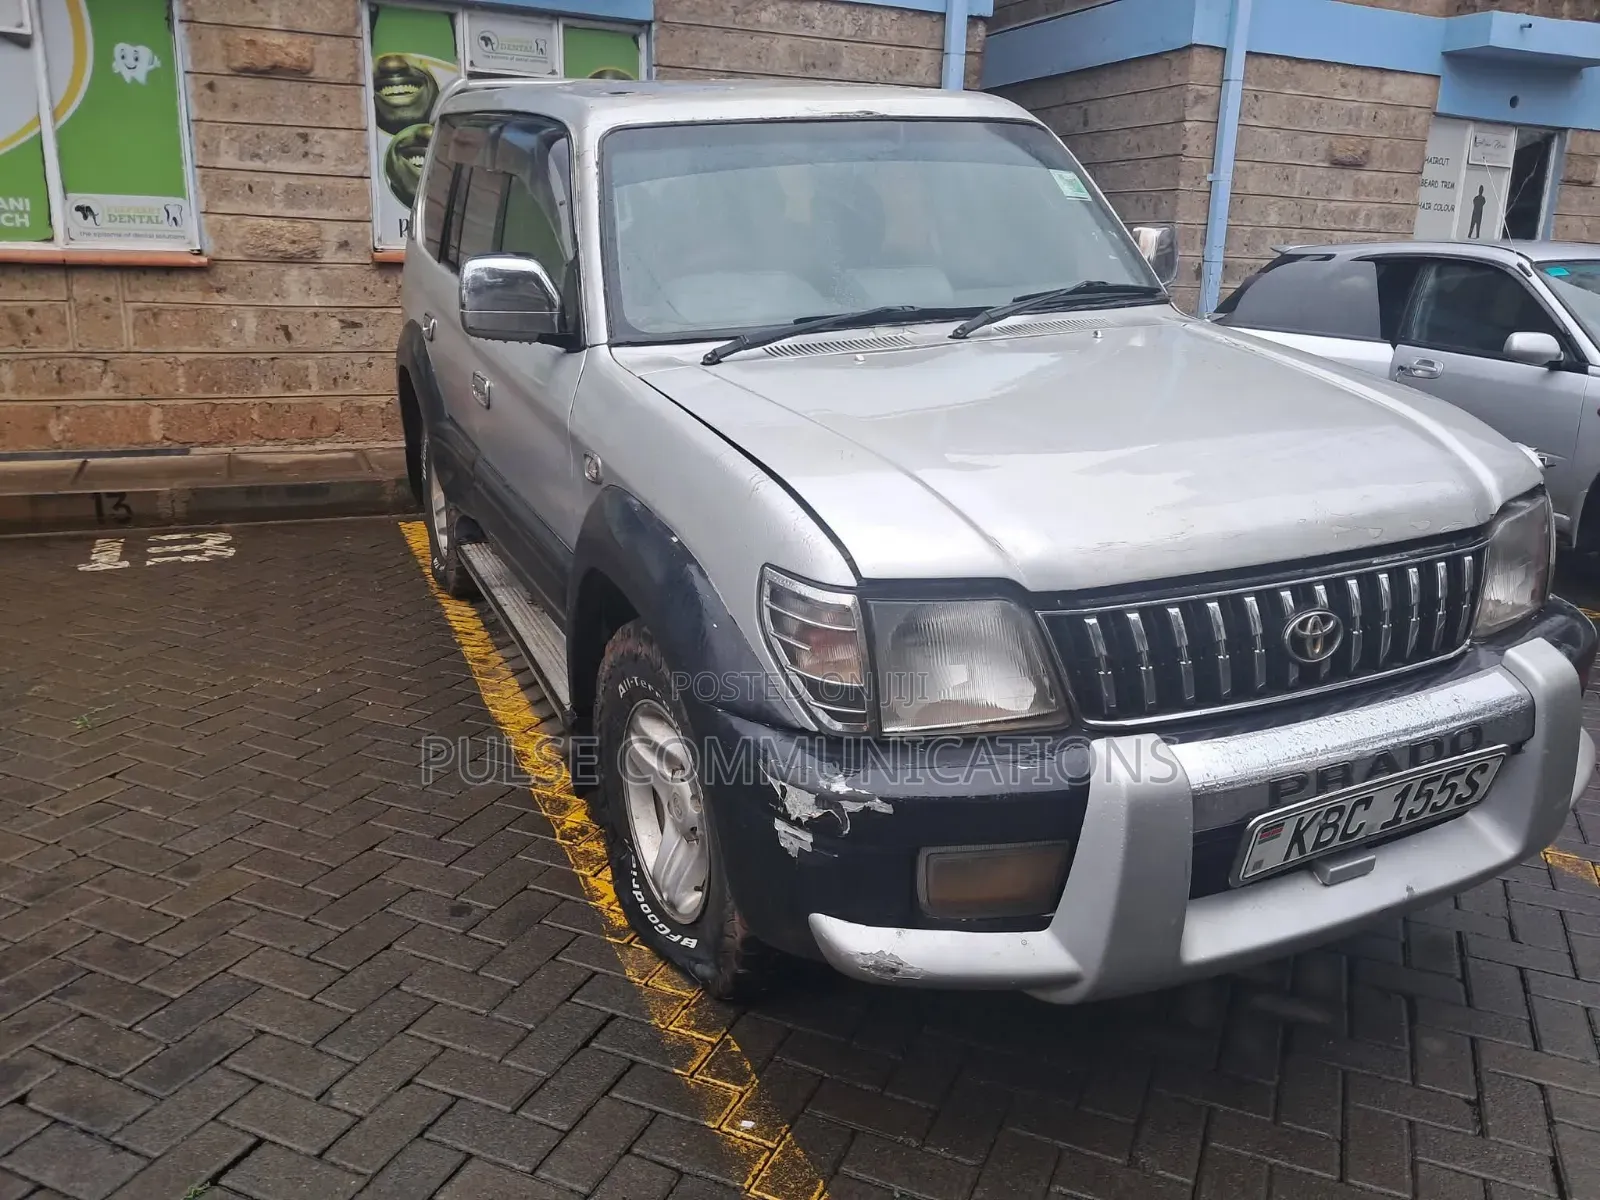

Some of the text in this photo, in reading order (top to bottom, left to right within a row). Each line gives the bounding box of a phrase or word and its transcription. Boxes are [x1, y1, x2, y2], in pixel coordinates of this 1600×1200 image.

[1424, 155, 1450, 166] HAIRCUT
[1420, 178, 1455, 190] BEARD TRIM
[1433, 202, 1455, 213] COLOUR
[107, 213, 164, 225] DENTAL
[91, 491, 134, 525] 13
[1268, 724, 1483, 808] PRADO
[1283, 761, 1490, 862] KBC 155S
